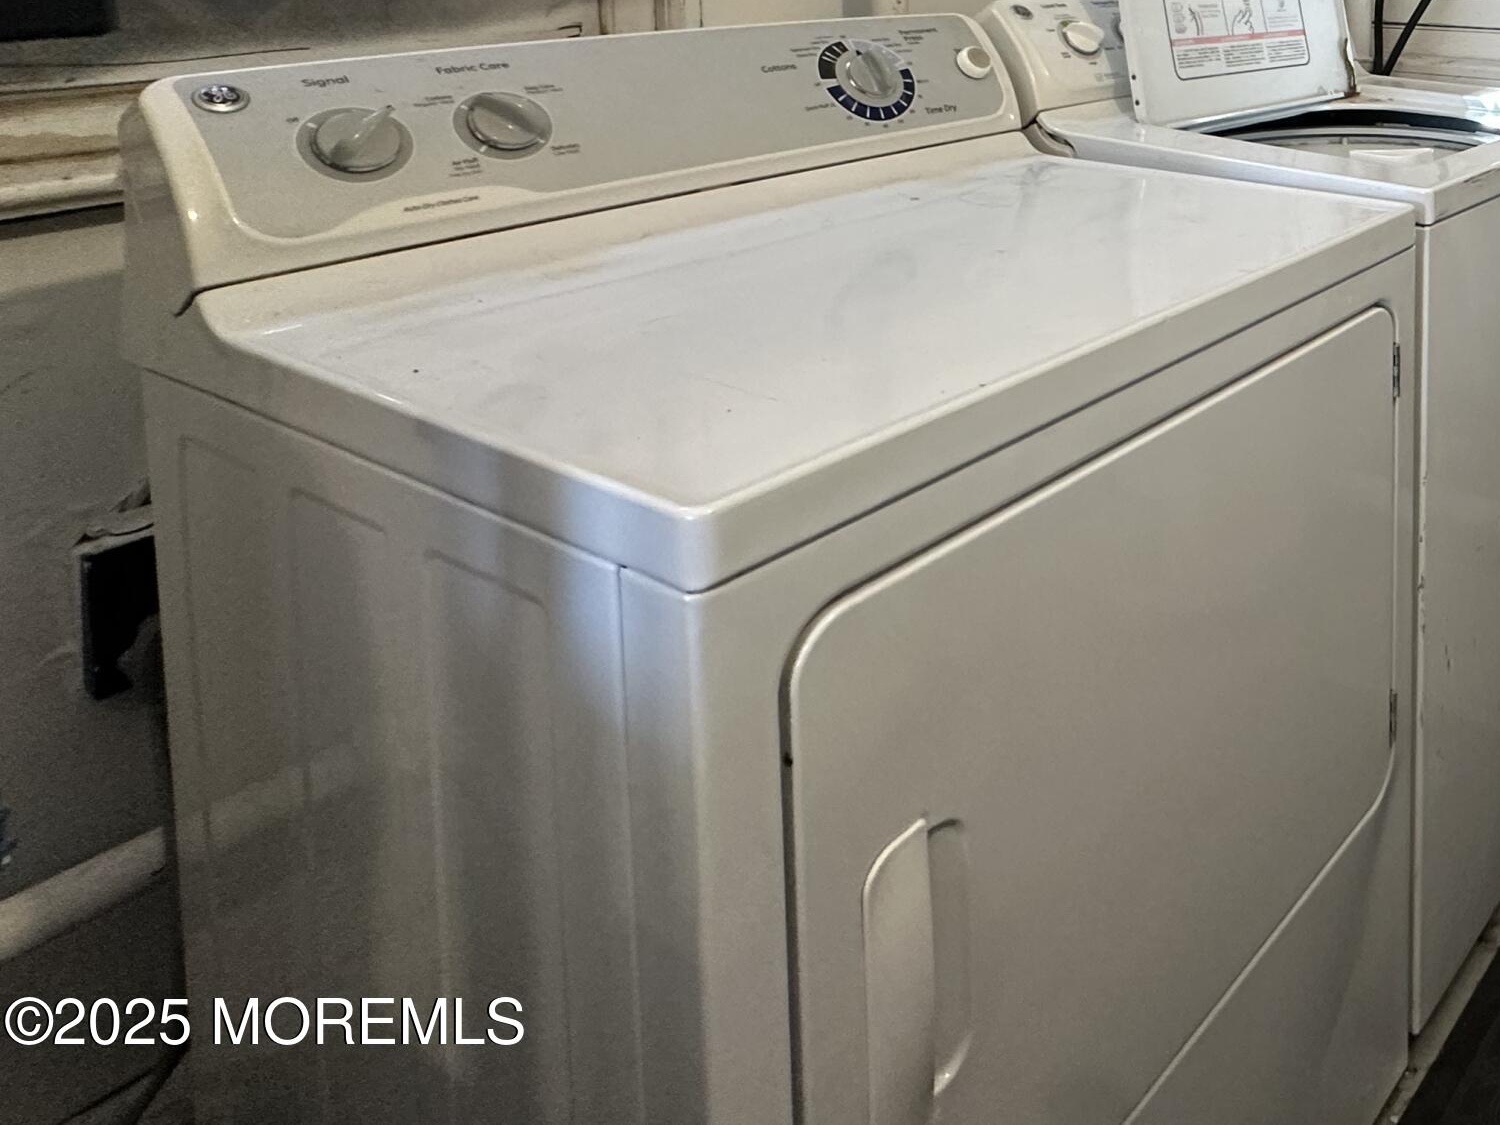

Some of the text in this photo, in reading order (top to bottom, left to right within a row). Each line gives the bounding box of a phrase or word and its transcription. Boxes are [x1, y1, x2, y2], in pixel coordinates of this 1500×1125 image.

[435, 62, 510, 76] Fabric Care
[761, 62, 798, 74] Cottons
[301, 75, 350, 88] Signal
[925, 104, 958, 115] Time Dry
